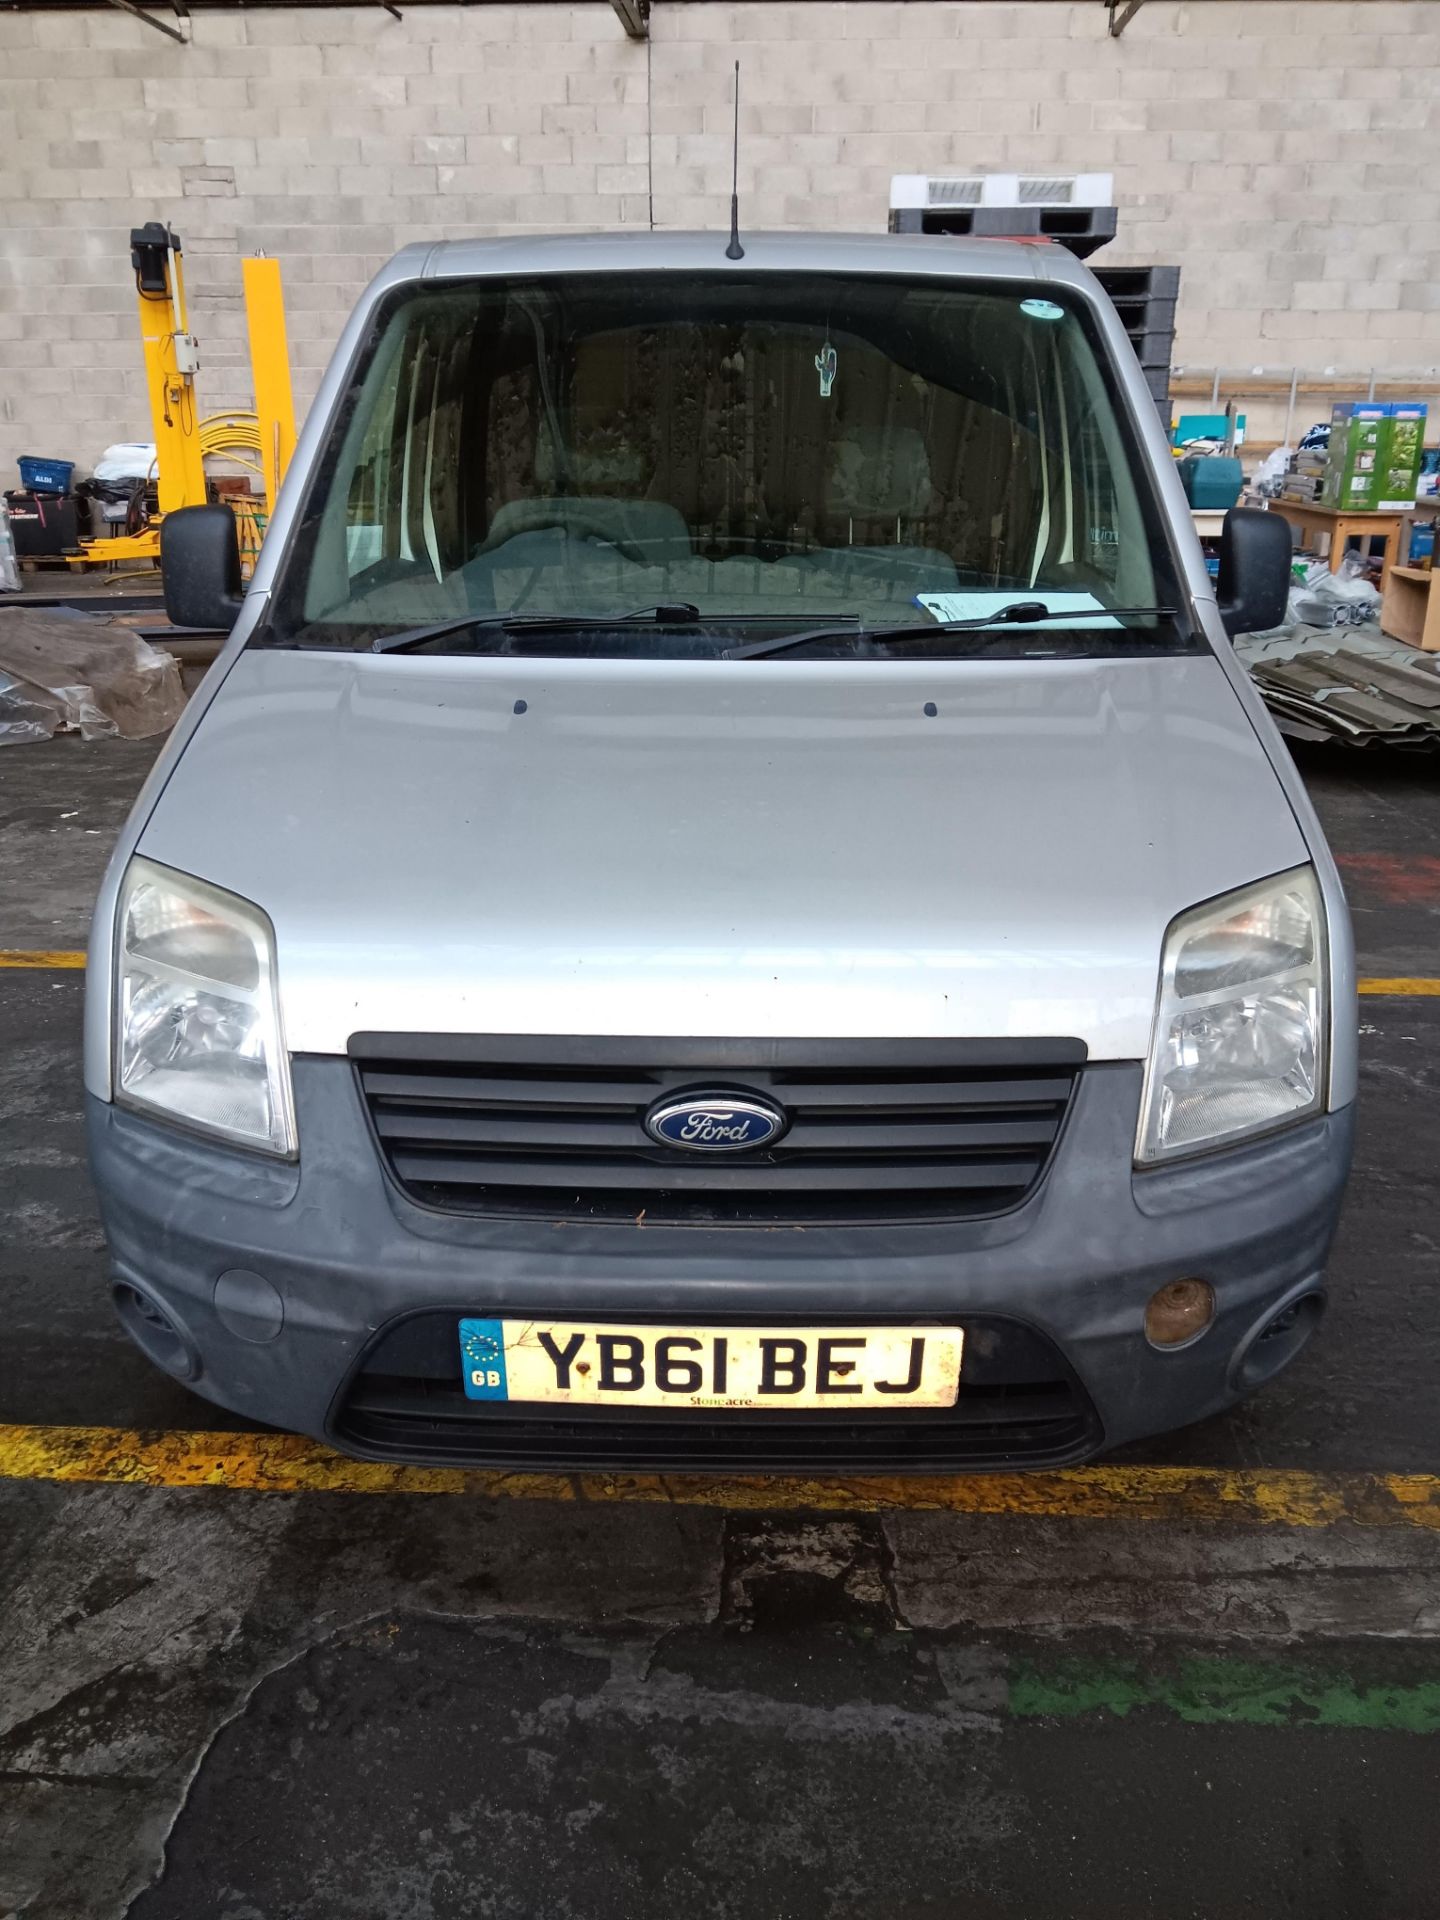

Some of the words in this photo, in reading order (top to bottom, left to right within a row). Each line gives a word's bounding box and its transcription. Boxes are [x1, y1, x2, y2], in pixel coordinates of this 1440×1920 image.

[35, 475, 52, 484] ALDI
[680, 1112, 751, 1140] Ford
[537, 1332, 728, 1394] YB61
[758, 1337, 926, 1394] BEJ
[471, 1370, 501, 1387] GB
[690, 1396, 753, 1406] Stoneacre
